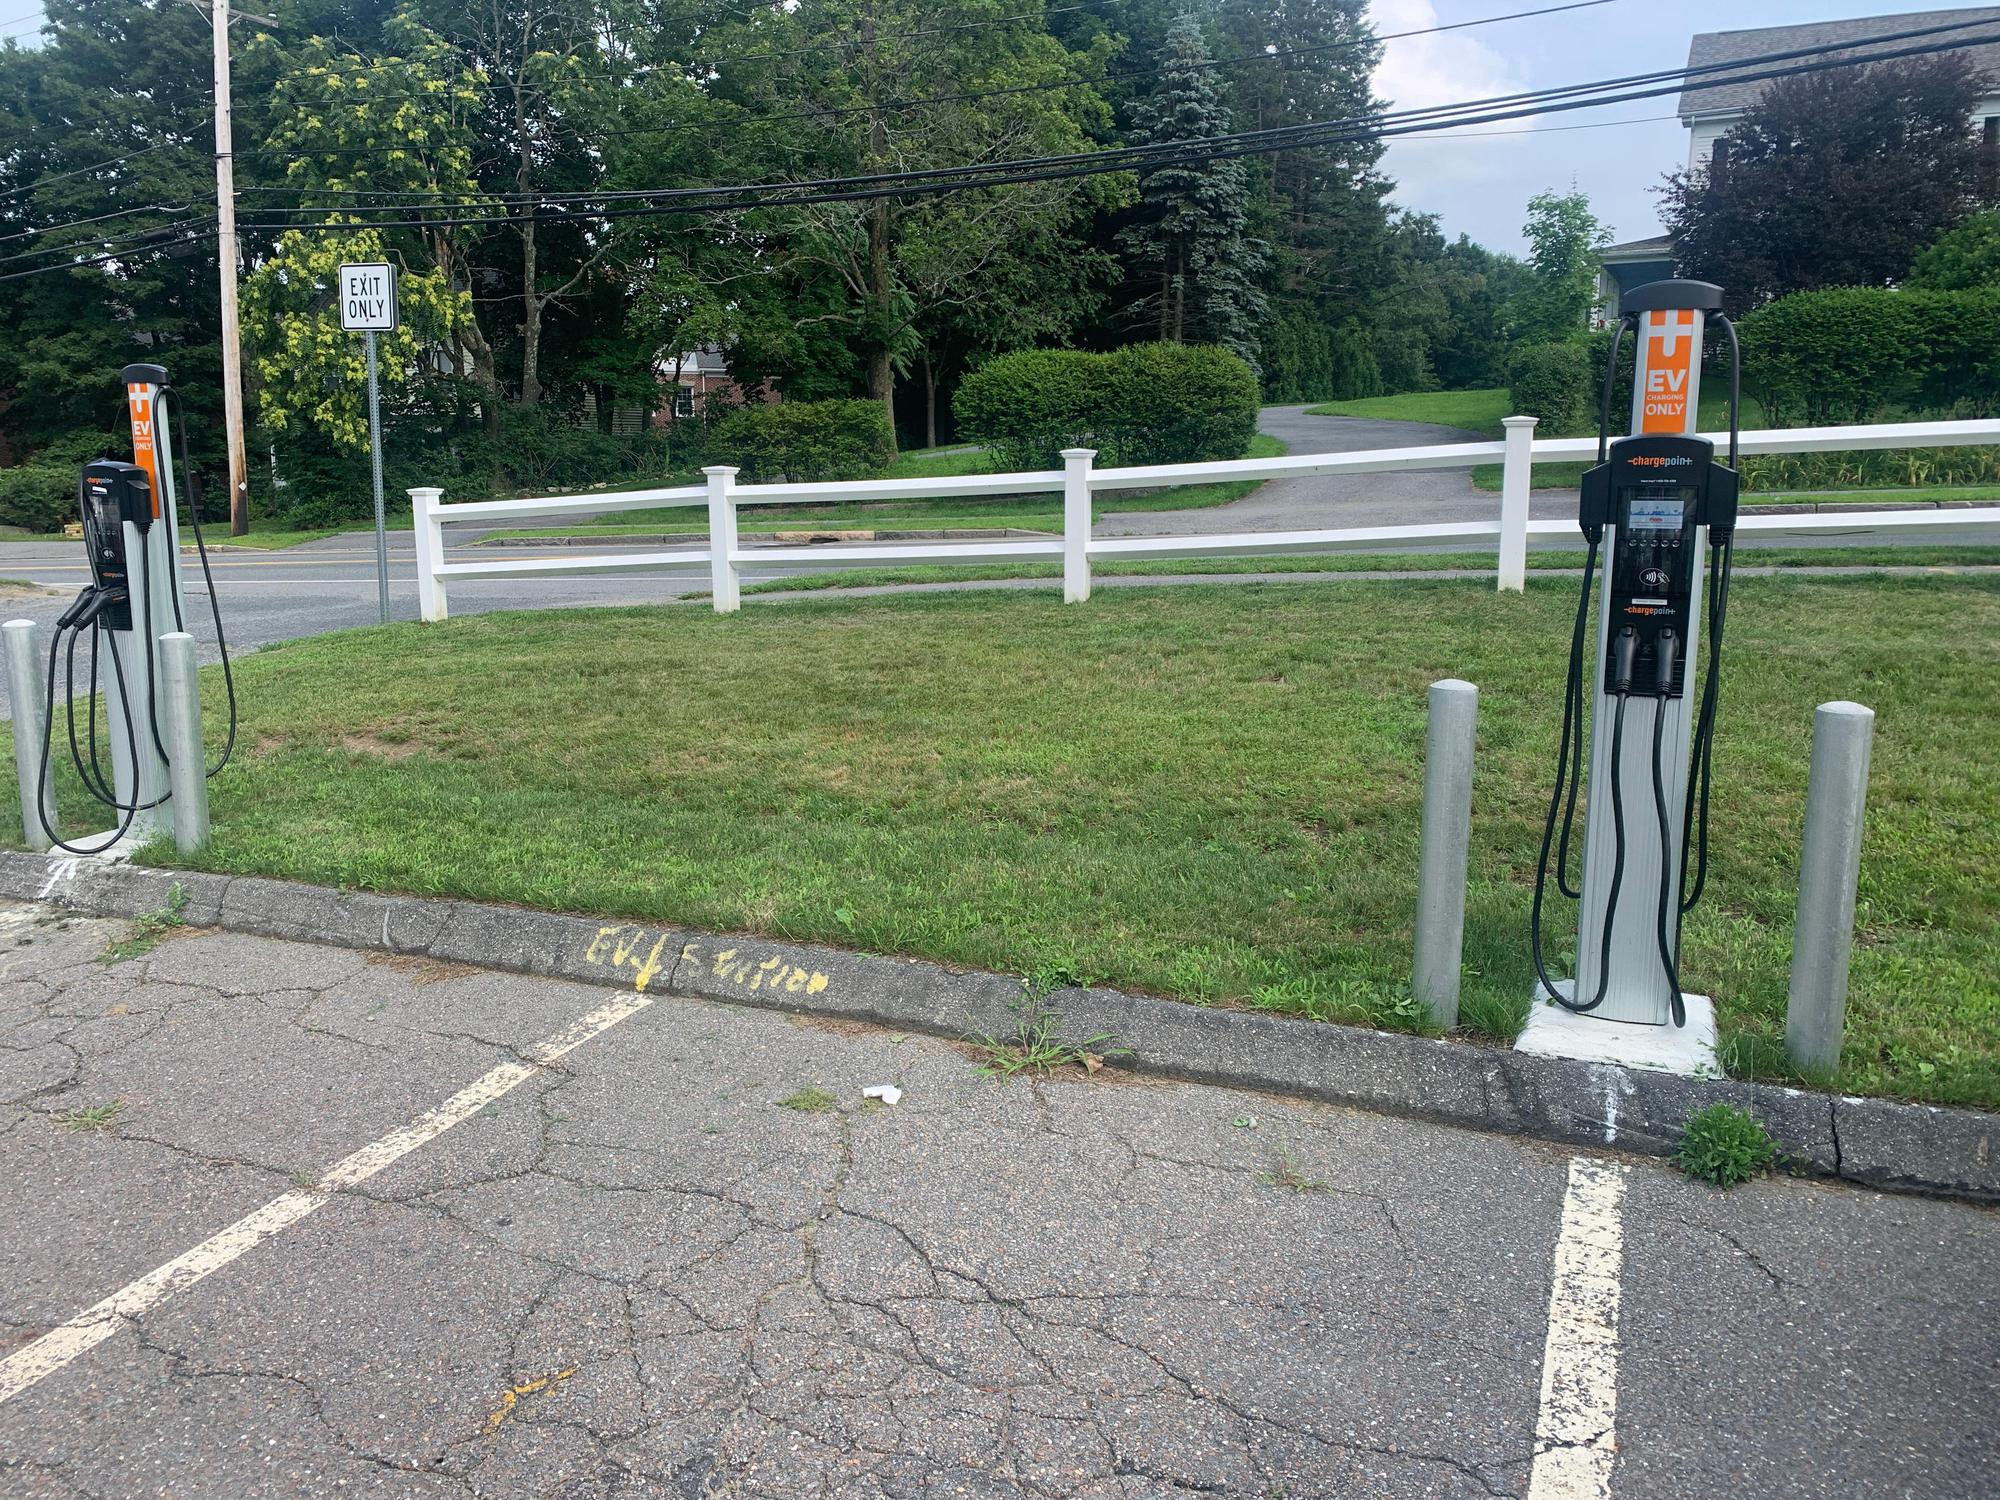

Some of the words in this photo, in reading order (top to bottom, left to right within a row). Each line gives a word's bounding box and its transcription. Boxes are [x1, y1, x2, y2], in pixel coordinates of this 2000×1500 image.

[350, 277, 381, 296] EXIT
[348, 299, 385, 319] ONLY
[1647, 369, 1687, 392] EV
[1645, 403, 1686, 416] ONLY
[133, 420, 150, 435] EV
[135, 442, 152, 450] ONLY
